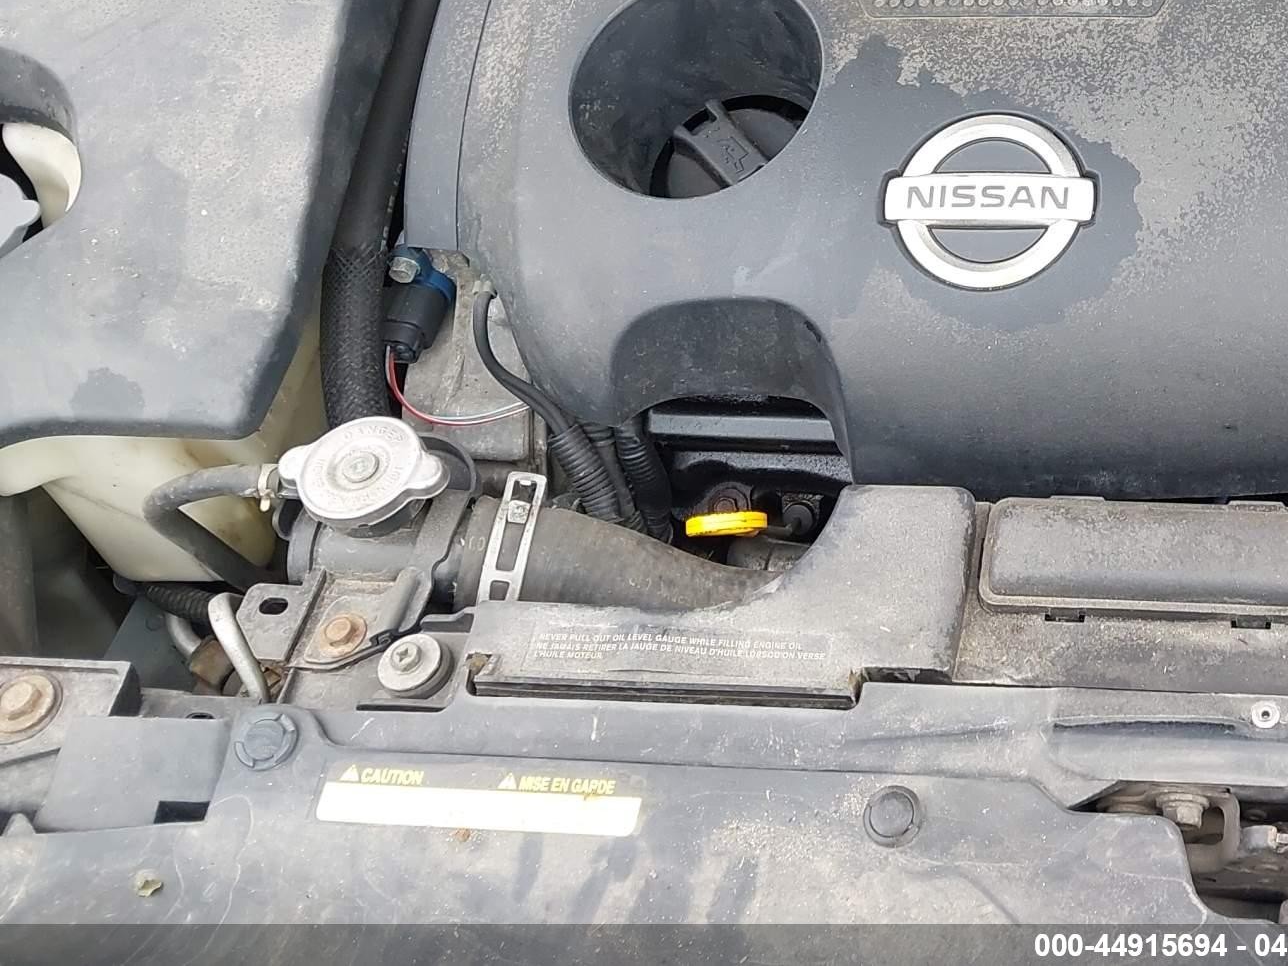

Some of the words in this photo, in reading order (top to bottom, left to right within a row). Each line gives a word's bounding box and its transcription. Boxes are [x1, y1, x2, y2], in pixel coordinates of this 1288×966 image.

[905, 184, 1070, 210] NISSAN
[581, 643, 618, 652] RETIRER
[618, 643, 629, 651] LA
[630, 643, 659, 652] JAUGE
[659, 644, 673, 653] DE
[674, 646, 707, 655] NIVEAU
[796, 652, 826, 661] VERSE
[592, 634, 612, 643] OUT
[612, 634, 626, 642] OIL
[627, 634, 653, 642] LEVEL
[655, 635, 687, 645] GAUGE
[689, 636, 716, 647] WHILE
[718, 639, 751, 649] FILLING
[753, 641, 786, 651] ENGINE
[788, 641, 802, 651] OIL
[360, 767, 424, 786] CAUTION
[518, 775, 551, 793] MISE
[551, 777, 570, 793] EN
[571, 778, 617, 795] GARDE
